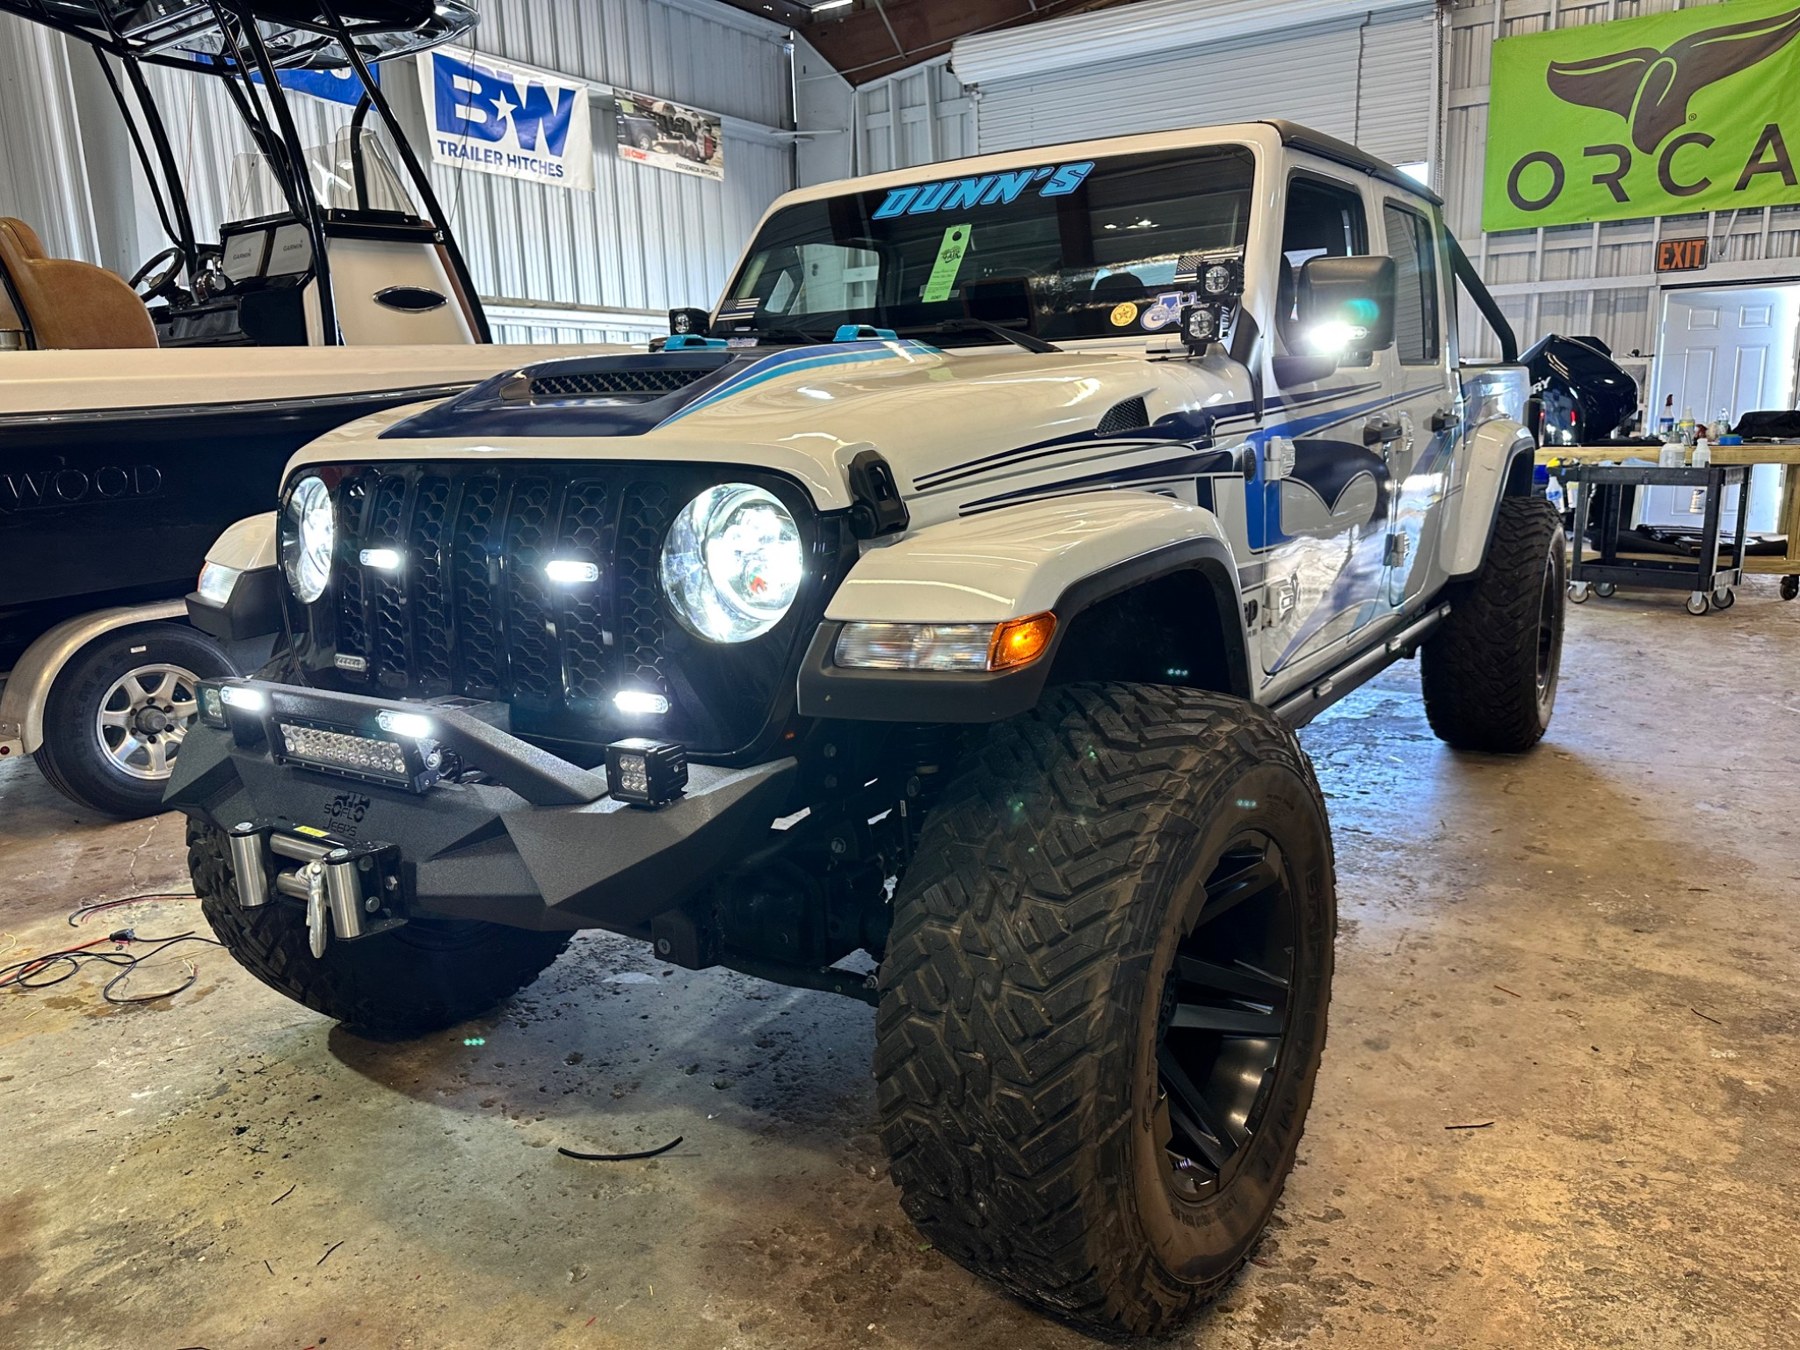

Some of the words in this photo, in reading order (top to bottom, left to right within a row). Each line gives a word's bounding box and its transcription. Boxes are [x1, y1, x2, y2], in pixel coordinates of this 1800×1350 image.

[437, 139, 503, 167] TRAILER
[506, 153, 564, 178] HITCHES
[1507, 123, 1799, 212] ORCA
[871, 161, 1095, 220] DUNN'S
[283, 243, 303, 252] GARMIN
[1658, 239, 1707, 270] EXIT
[0, 464, 163, 510] WOOD
[322, 818, 358, 836] JEEPS
